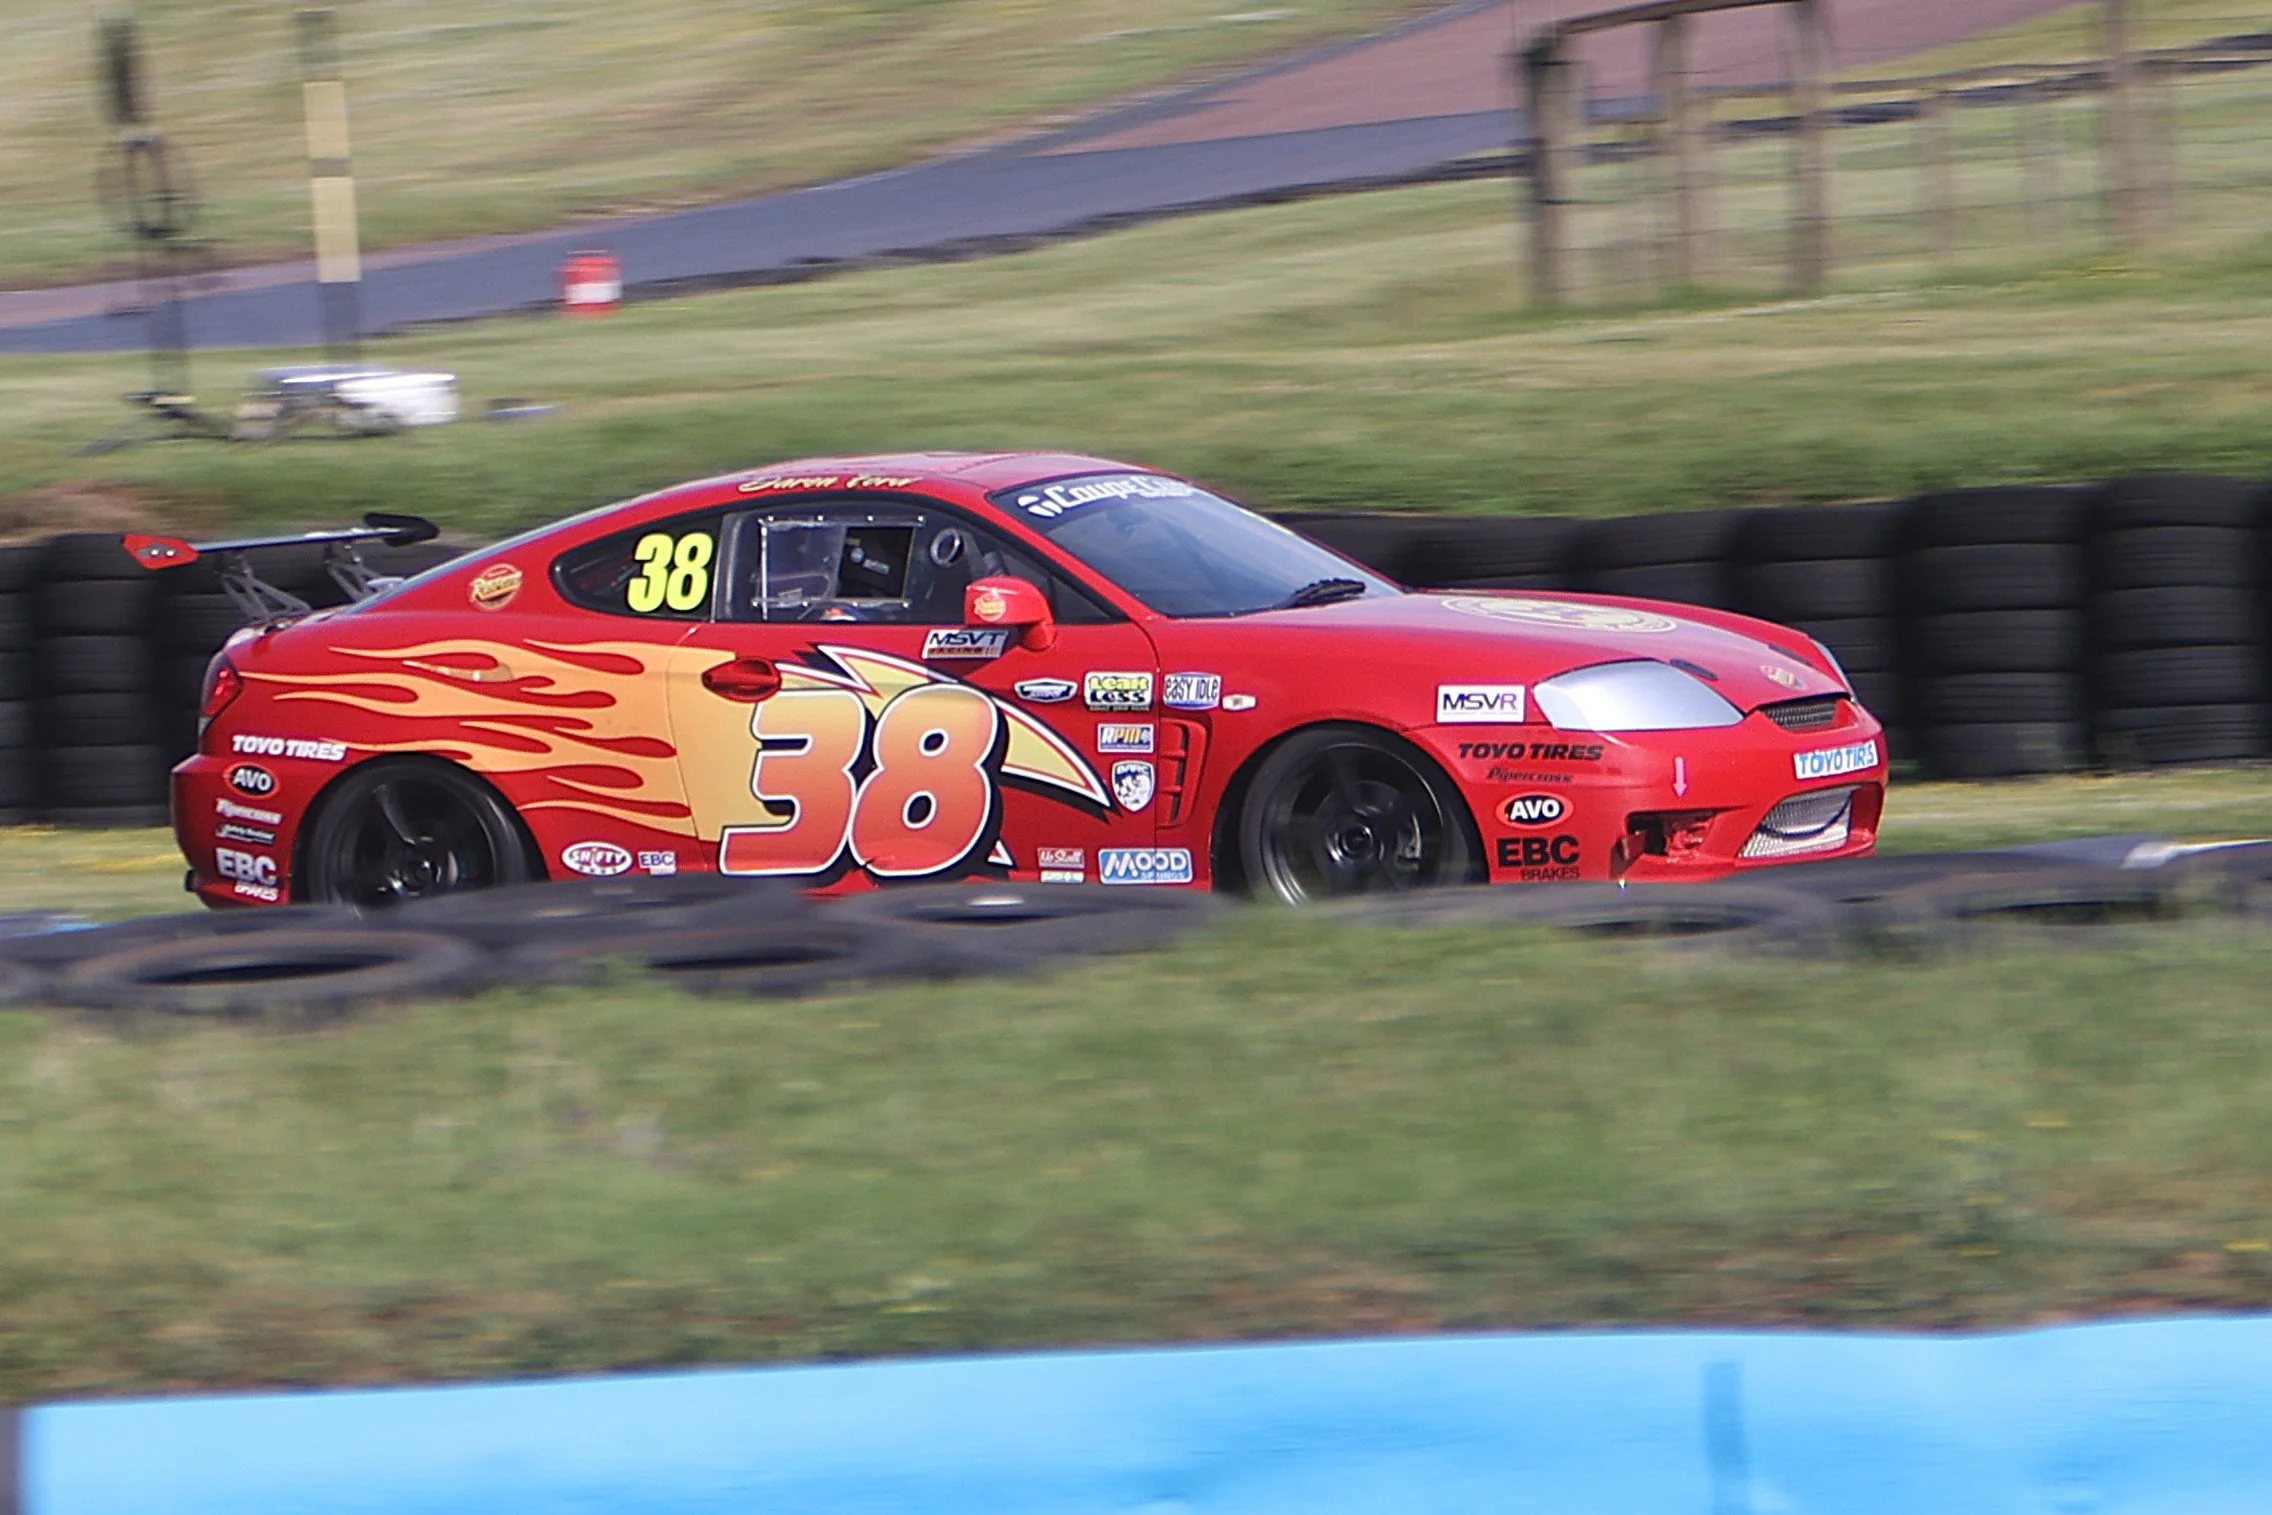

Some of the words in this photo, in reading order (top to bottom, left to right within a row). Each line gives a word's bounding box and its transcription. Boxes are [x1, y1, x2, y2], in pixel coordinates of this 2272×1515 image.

[627, 532, 714, 612] 38
[929, 632, 1003, 645] MSVT
[1443, 693, 1518, 711] MSVR
[232, 734, 284, 756] TOYO
[286, 739, 347, 761] TIRES
[1459, 743, 1525, 760] TOYO
[1530, 743, 1604, 760] TIRES
[1799, 750, 1843, 775] TOYO
[233, 768, 272, 791] AVO
[719, 683, 998, 876] 38
[1510, 800, 1559, 820] AVO
[640, 853, 674, 866] EBC
[1497, 835, 1579, 868] EBC
[216, 848, 277, 886] EBC
[1103, 852, 1187, 877] MOOD
[1521, 866, 1580, 881] BRAKES
